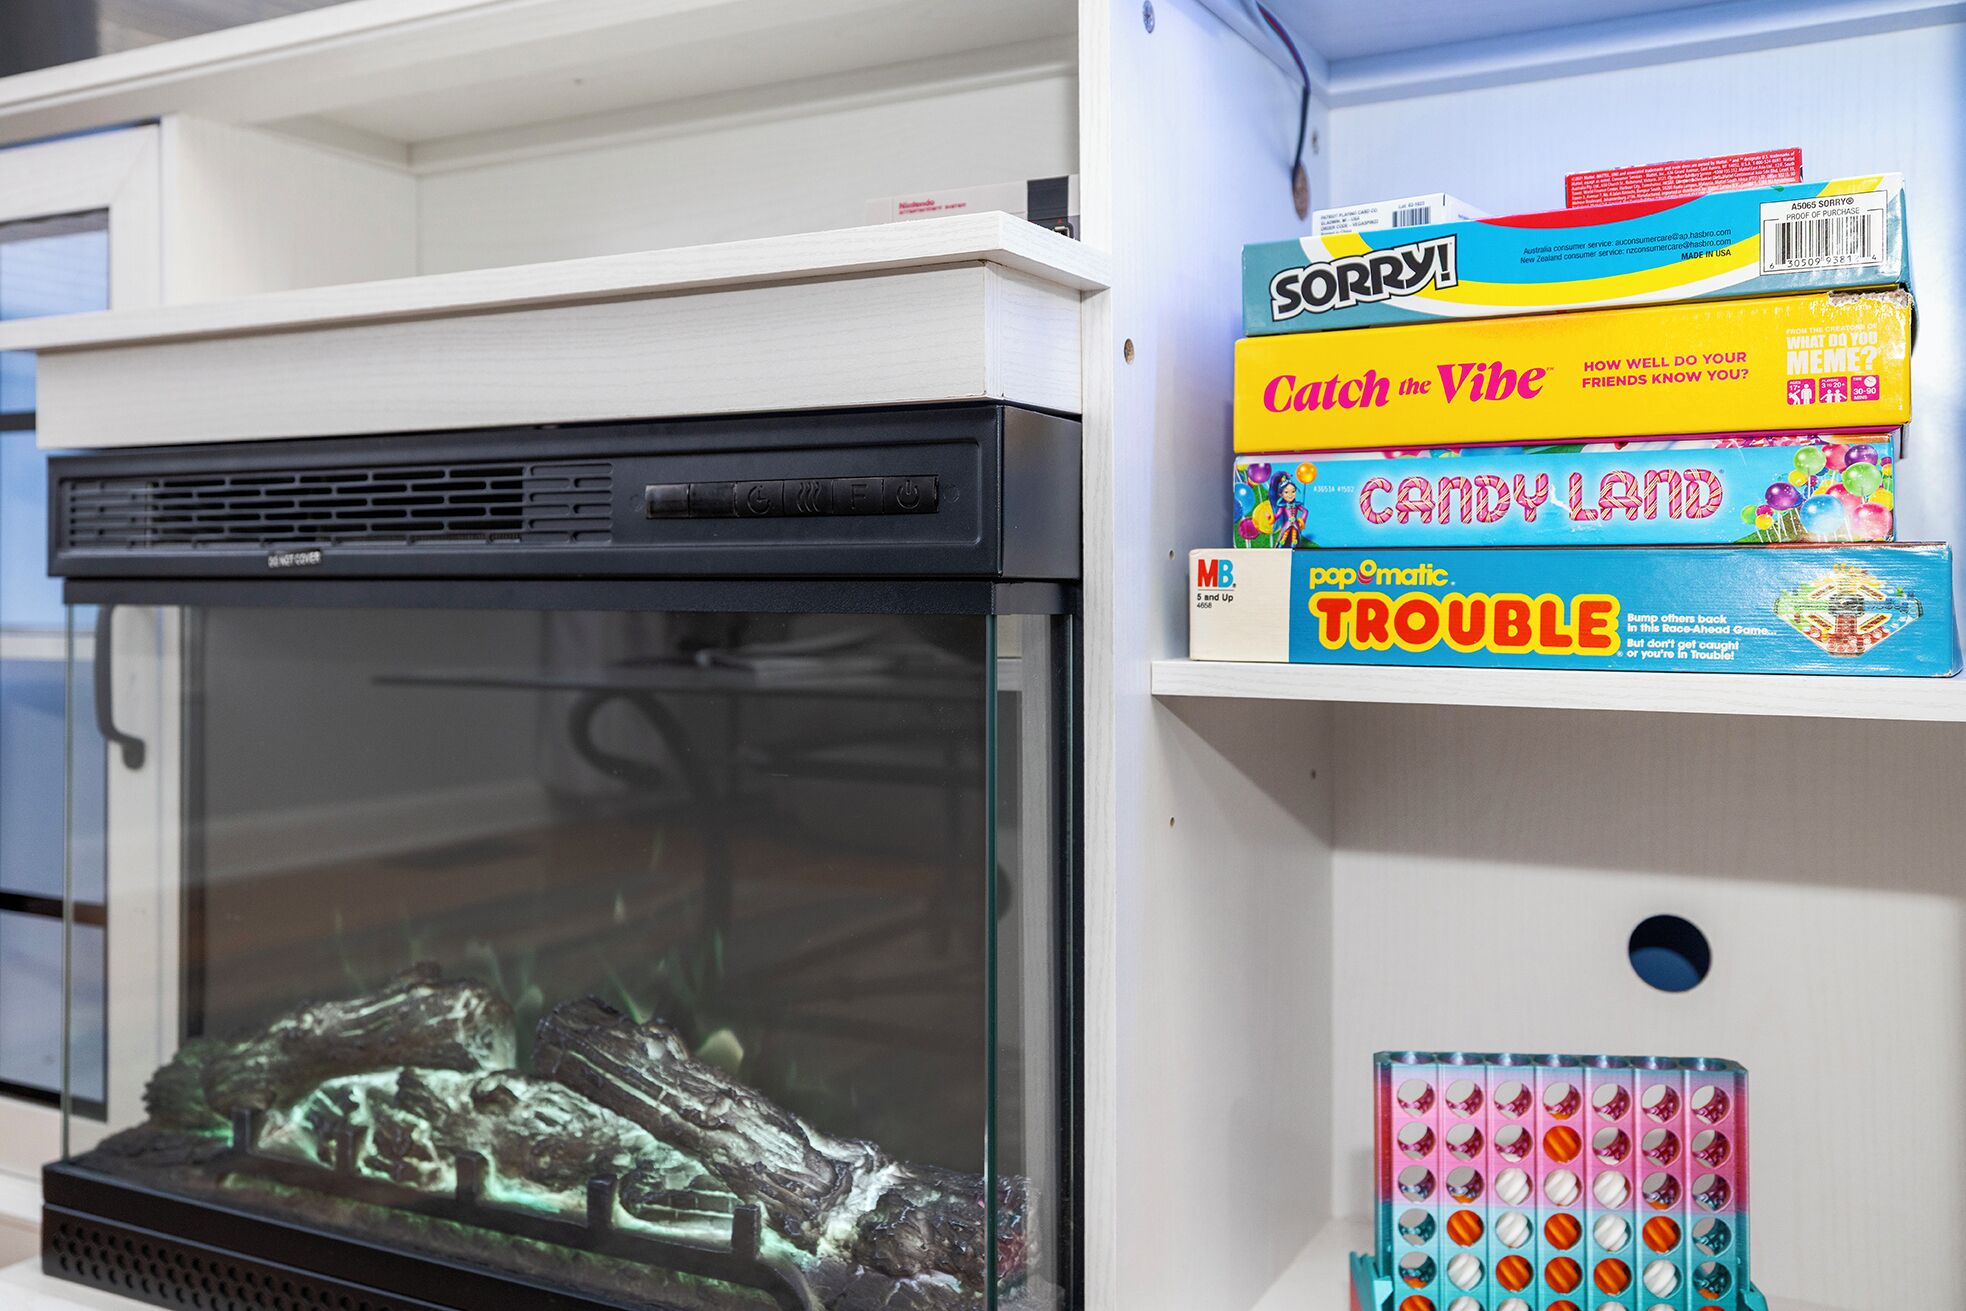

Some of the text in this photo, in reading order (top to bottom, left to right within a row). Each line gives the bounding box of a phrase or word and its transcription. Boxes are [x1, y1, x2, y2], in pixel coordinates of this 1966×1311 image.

[899, 198, 935, 209] Nintendo
[1787, 211, 1809, 220] PROOF
[1822, 207, 1860, 217] PURCHASE
[1523, 228, 1731, 254] Australia consumer service: auconsumercare@ap.hasbro.com
[1536, 252, 1562, 262] Zealand
[1564, 250, 1596, 260] consumer
[1598, 248, 1625, 257] service:
[1626, 238, 1731, 254] nzconsumercare@hasbro.com
[1681, 250, 1704, 260] MADE
[1715, 248, 1731, 257] USA
[1788, 258, 1820, 267] 30509
[1273, 240, 1452, 316] SORRY!
[1786, 331, 1878, 350] WHAT DO YOU
[1584, 352, 1747, 372] HOW WELL DO YOUR
[1787, 346, 1877, 375] MEME?
[1582, 368, 1749, 388] FRIENDS KNOW YOU?
[1263, 369, 1390, 412] Catch
[1398, 377, 1432, 396] the
[1359, 469, 1723, 525] CANDY LAND
[1222, 593, 1234, 602] Up
[1313, 595, 1616, 652] TROUBLE
[1628, 613, 1727, 625] Bump others back
[1628, 623, 1777, 636] in this Race-Ahead Game...
[1627, 639, 1739, 652] But don't get caught
[1641, 650, 1674, 659] you're
[1678, 650, 1688, 658] in
[1690, 650, 1735, 660] Trouble!
